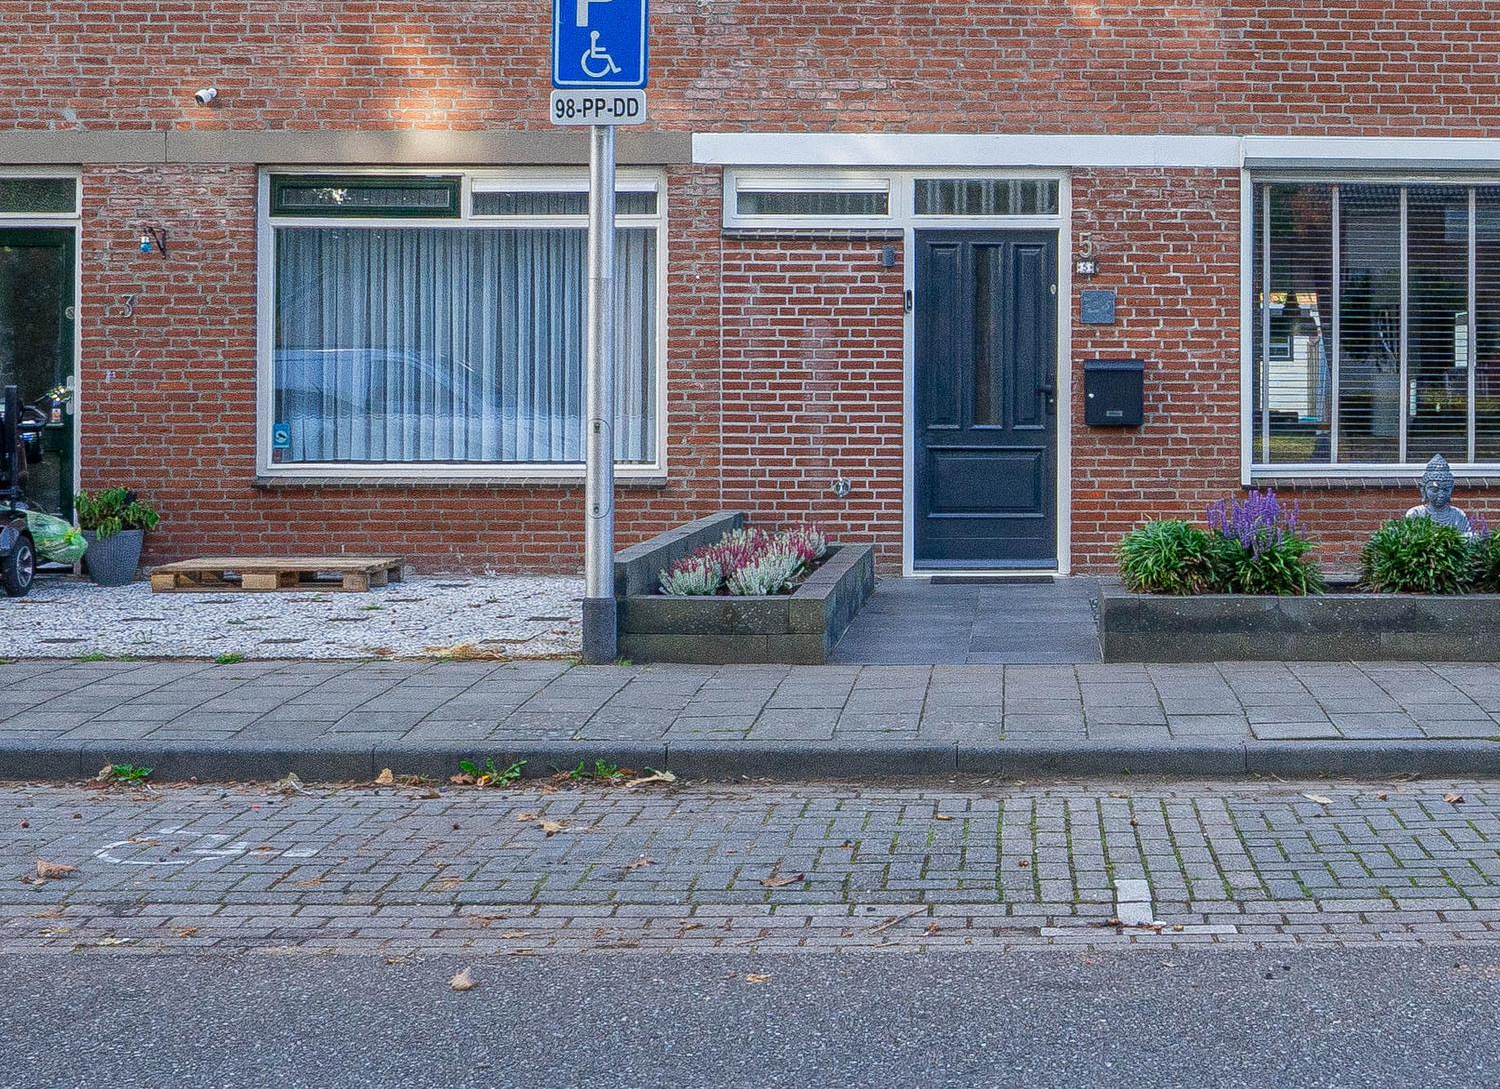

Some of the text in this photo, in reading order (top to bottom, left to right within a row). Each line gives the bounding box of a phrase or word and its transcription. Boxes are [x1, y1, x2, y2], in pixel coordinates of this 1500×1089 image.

[555, 97, 639, 119] 98-PP-DD
[1079, 232, 1092, 258] 5
[119, 294, 134, 318] 3
